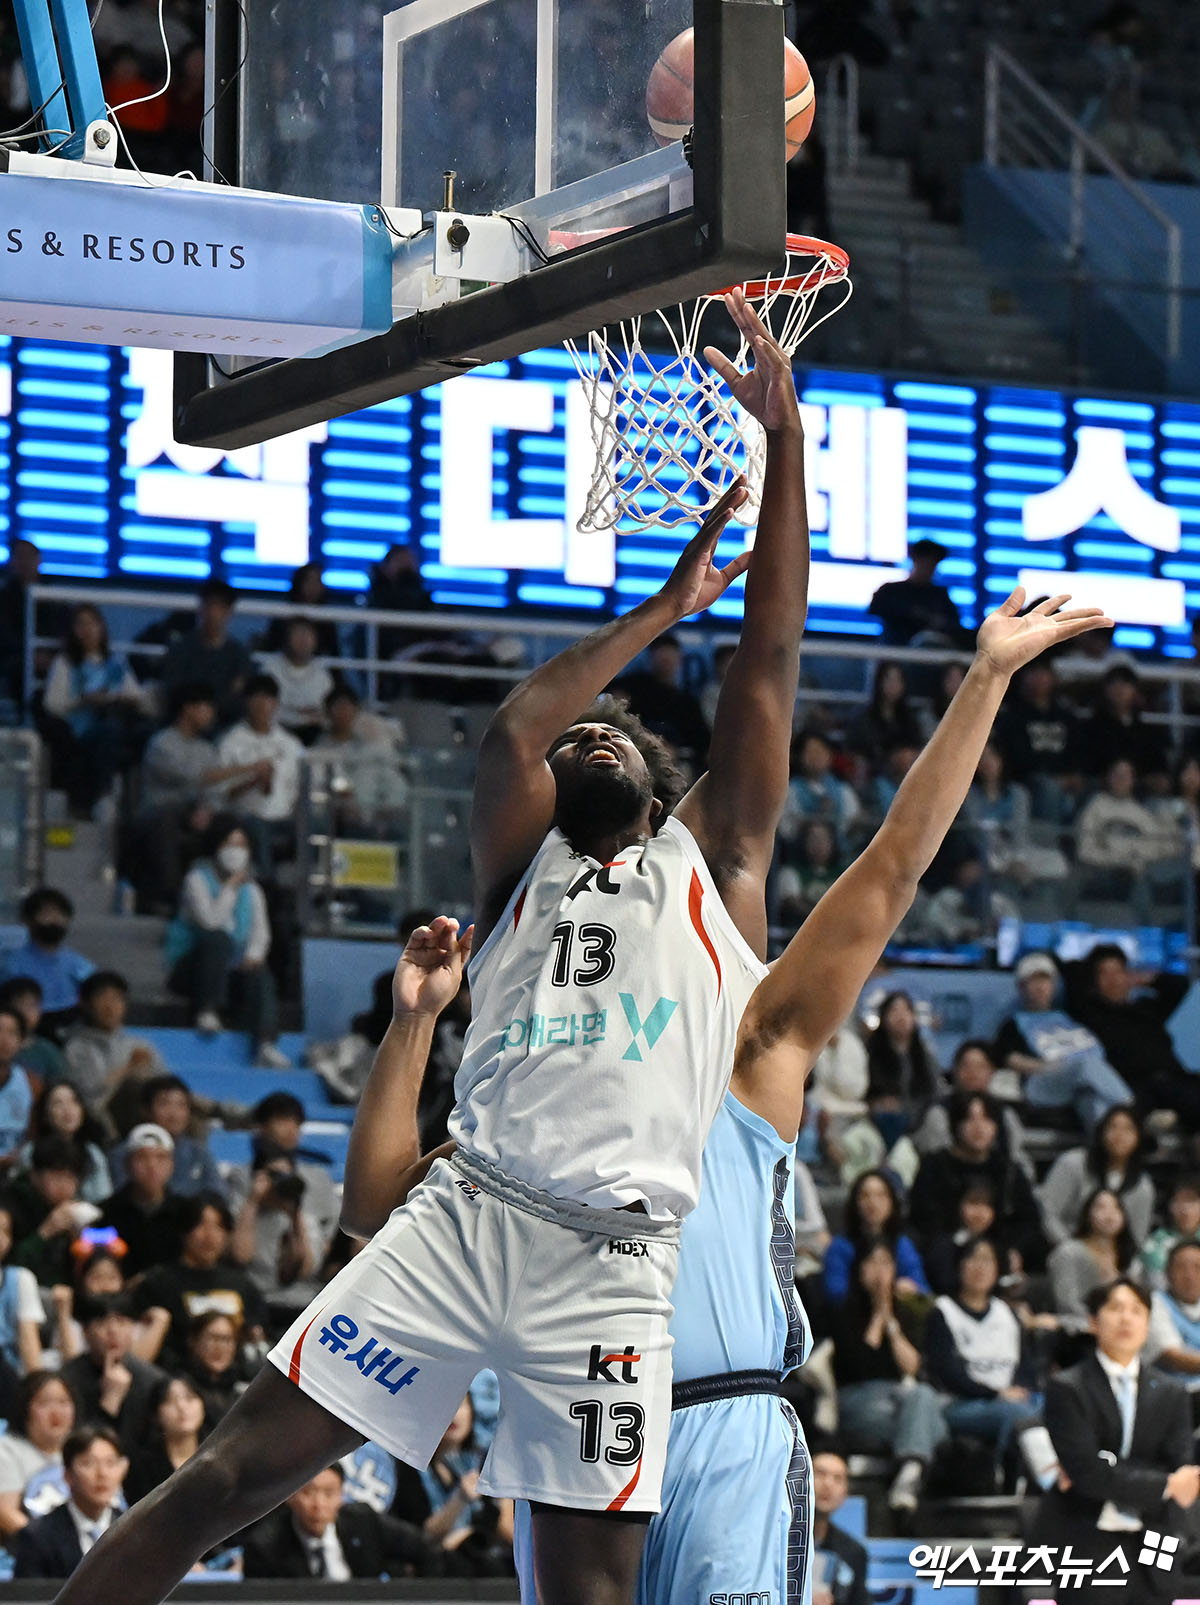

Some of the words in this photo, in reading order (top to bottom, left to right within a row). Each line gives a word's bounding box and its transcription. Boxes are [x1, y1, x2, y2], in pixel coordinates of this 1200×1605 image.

[6, 228, 23, 254] S
[41, 231, 65, 257] &
[83, 233, 246, 270] RESORTS
[551, 920, 617, 988] 13
[607, 1240, 650, 1258] HDEX
[318, 1313, 421, 1396] 유사나
[587, 1344, 641, 1384] kt
[568, 1399, 646, 1467] 13
